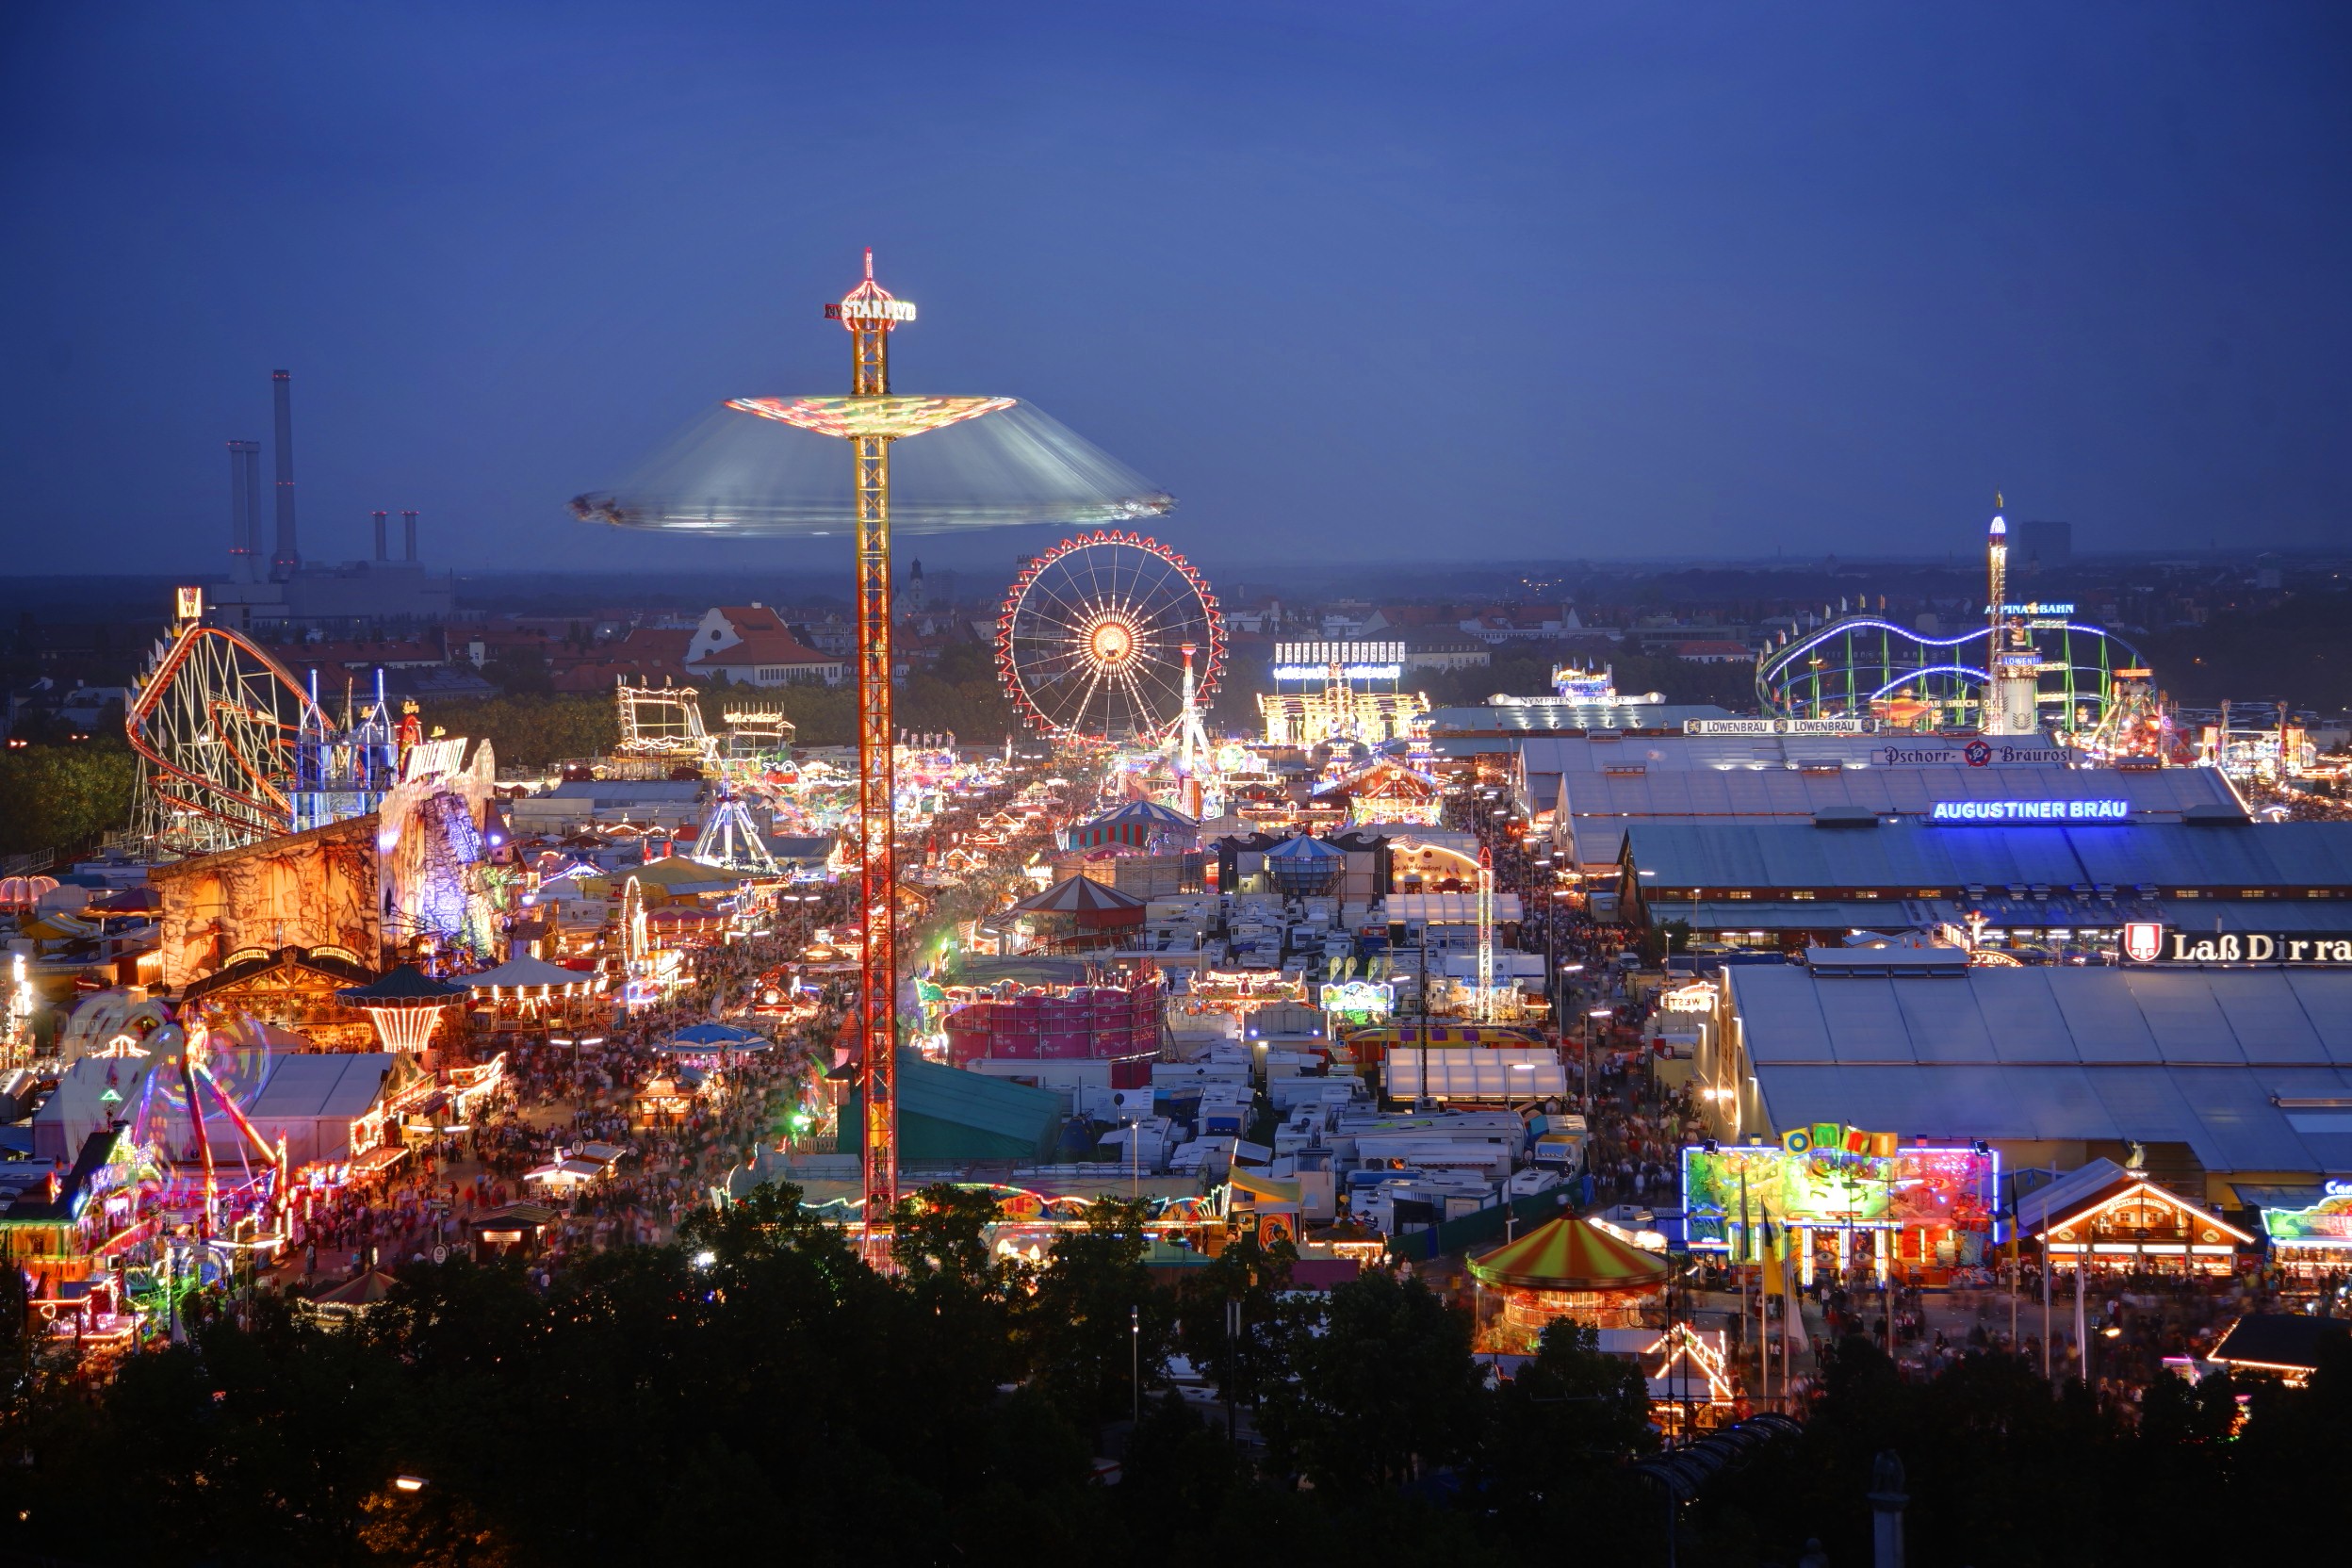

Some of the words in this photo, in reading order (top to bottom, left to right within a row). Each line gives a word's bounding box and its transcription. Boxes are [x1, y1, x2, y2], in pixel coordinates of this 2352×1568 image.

[2039, 604, 2073, 613] BAHN
[1520, 696, 1602, 705] NYMPHENRG
[1707, 720, 1767, 733] LÖWENBRÄU
[1794, 719, 1854, 732] LÖWENBRÄU
[1934, 802, 2066, 819] AUGUSTINER
[2069, 799, 2128, 818] BRÄU
[2172, 934, 2242, 960] Laß
[2246, 934, 2309, 960] Dir
